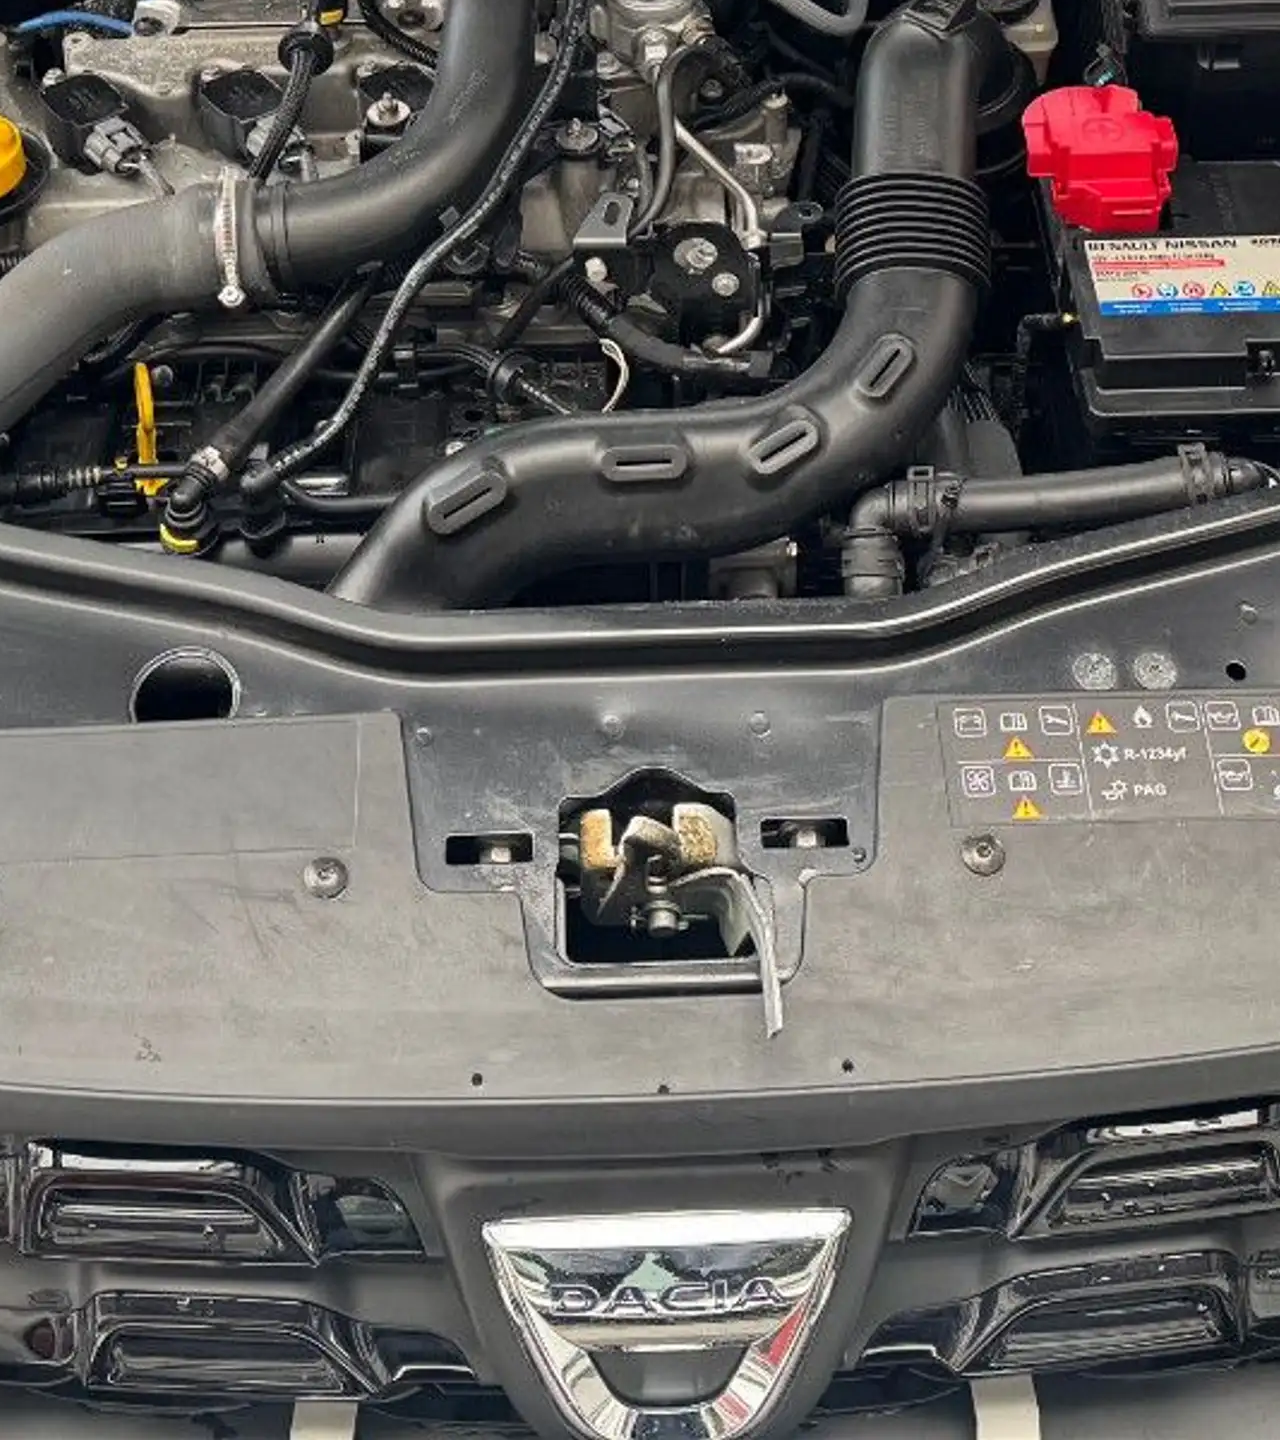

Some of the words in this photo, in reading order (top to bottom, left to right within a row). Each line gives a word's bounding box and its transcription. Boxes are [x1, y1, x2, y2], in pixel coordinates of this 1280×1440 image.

[1166, 239, 1238, 250] NISSAN
[1133, 783, 1168, 797] PAG
[551, 1277, 787, 1318] DACIA
